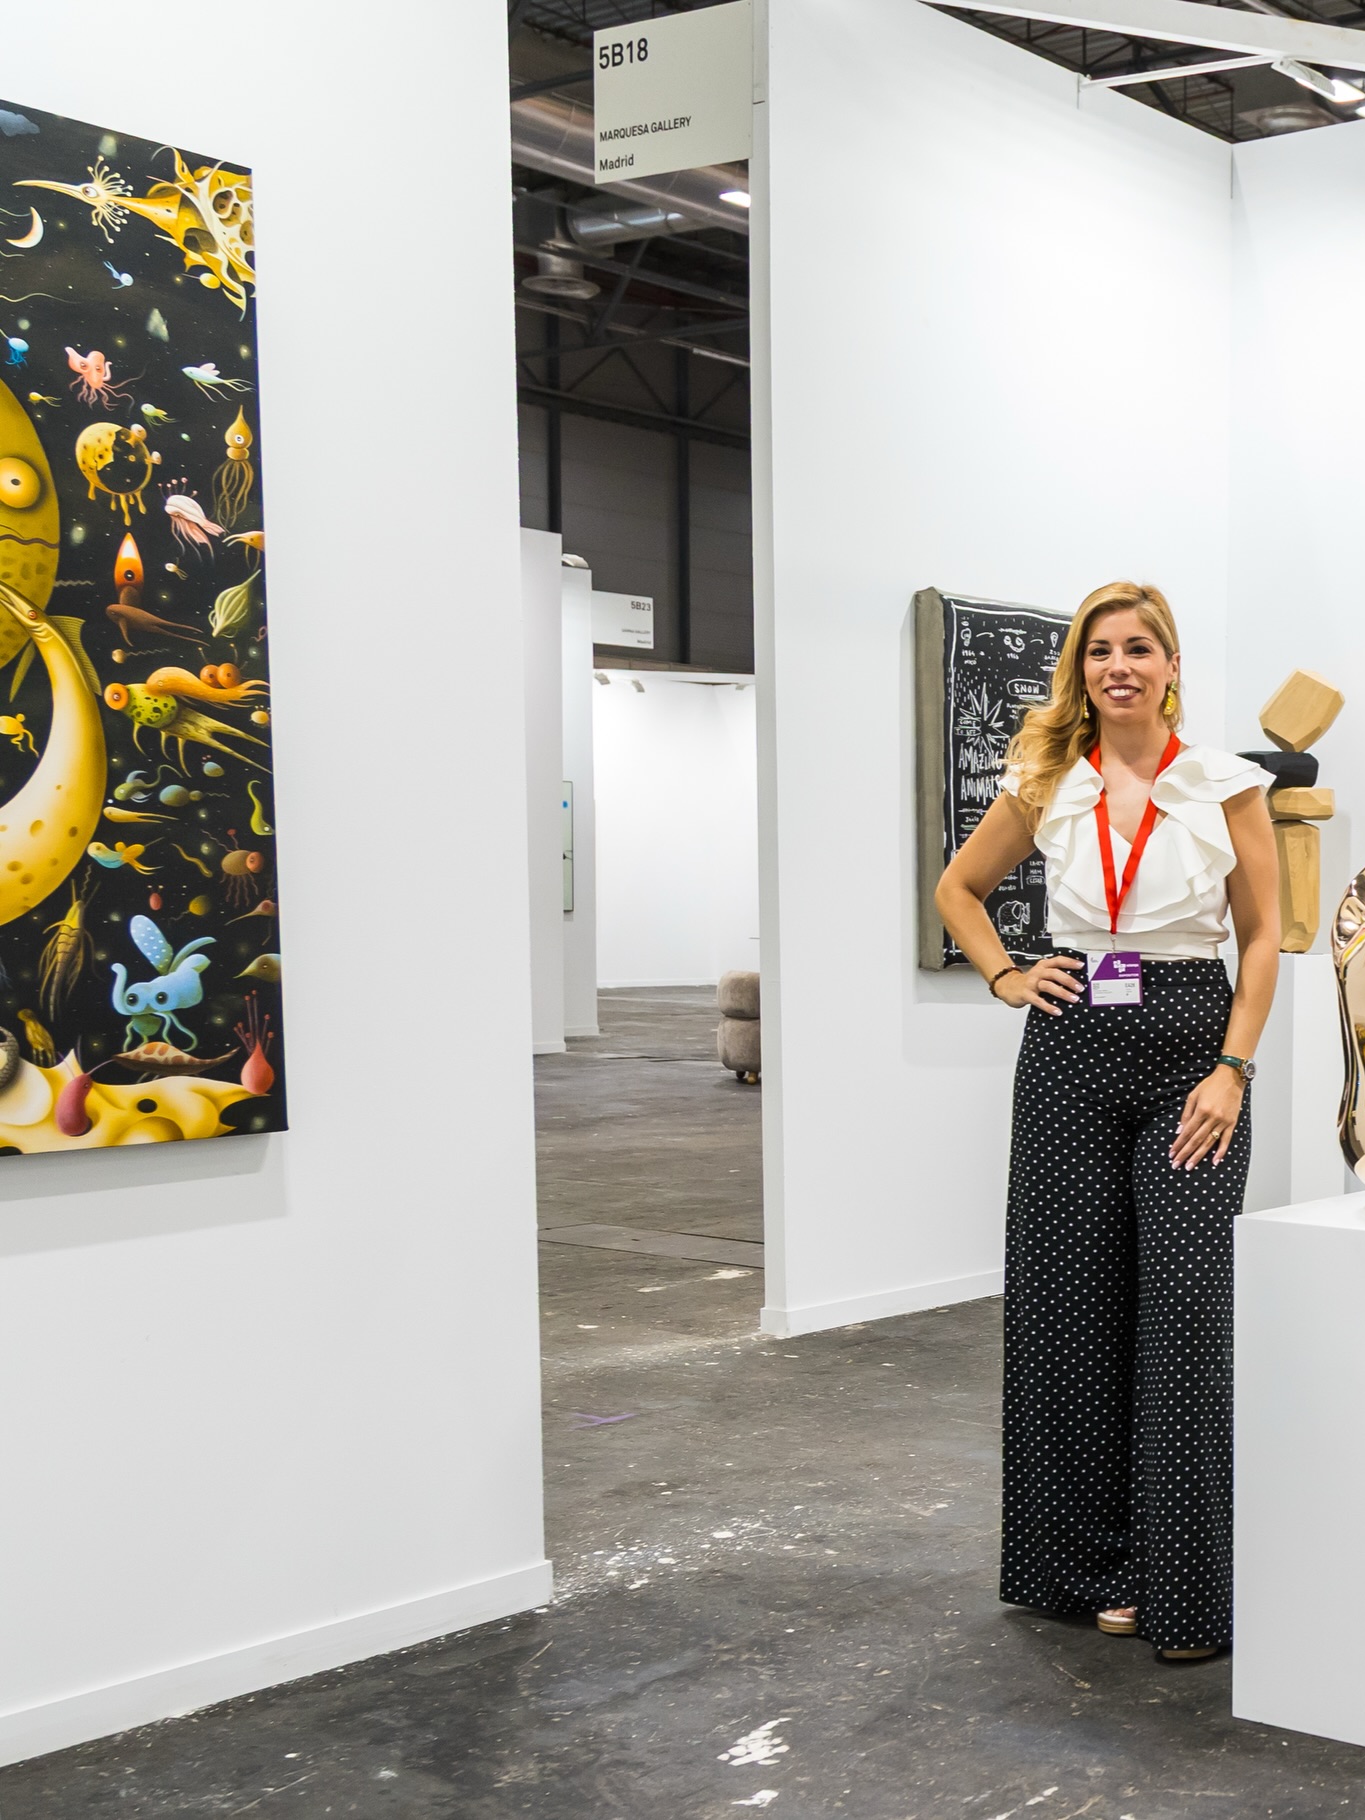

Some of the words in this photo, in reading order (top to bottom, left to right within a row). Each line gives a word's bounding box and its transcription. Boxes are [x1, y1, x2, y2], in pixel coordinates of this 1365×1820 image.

[598, 37, 649, 70] 5B18
[599, 123, 650, 142] MARQUESA
[650, 116, 692, 134] GALLERY
[599, 153, 634, 172] Madrid
[1014, 682, 1040, 695] SNOW
